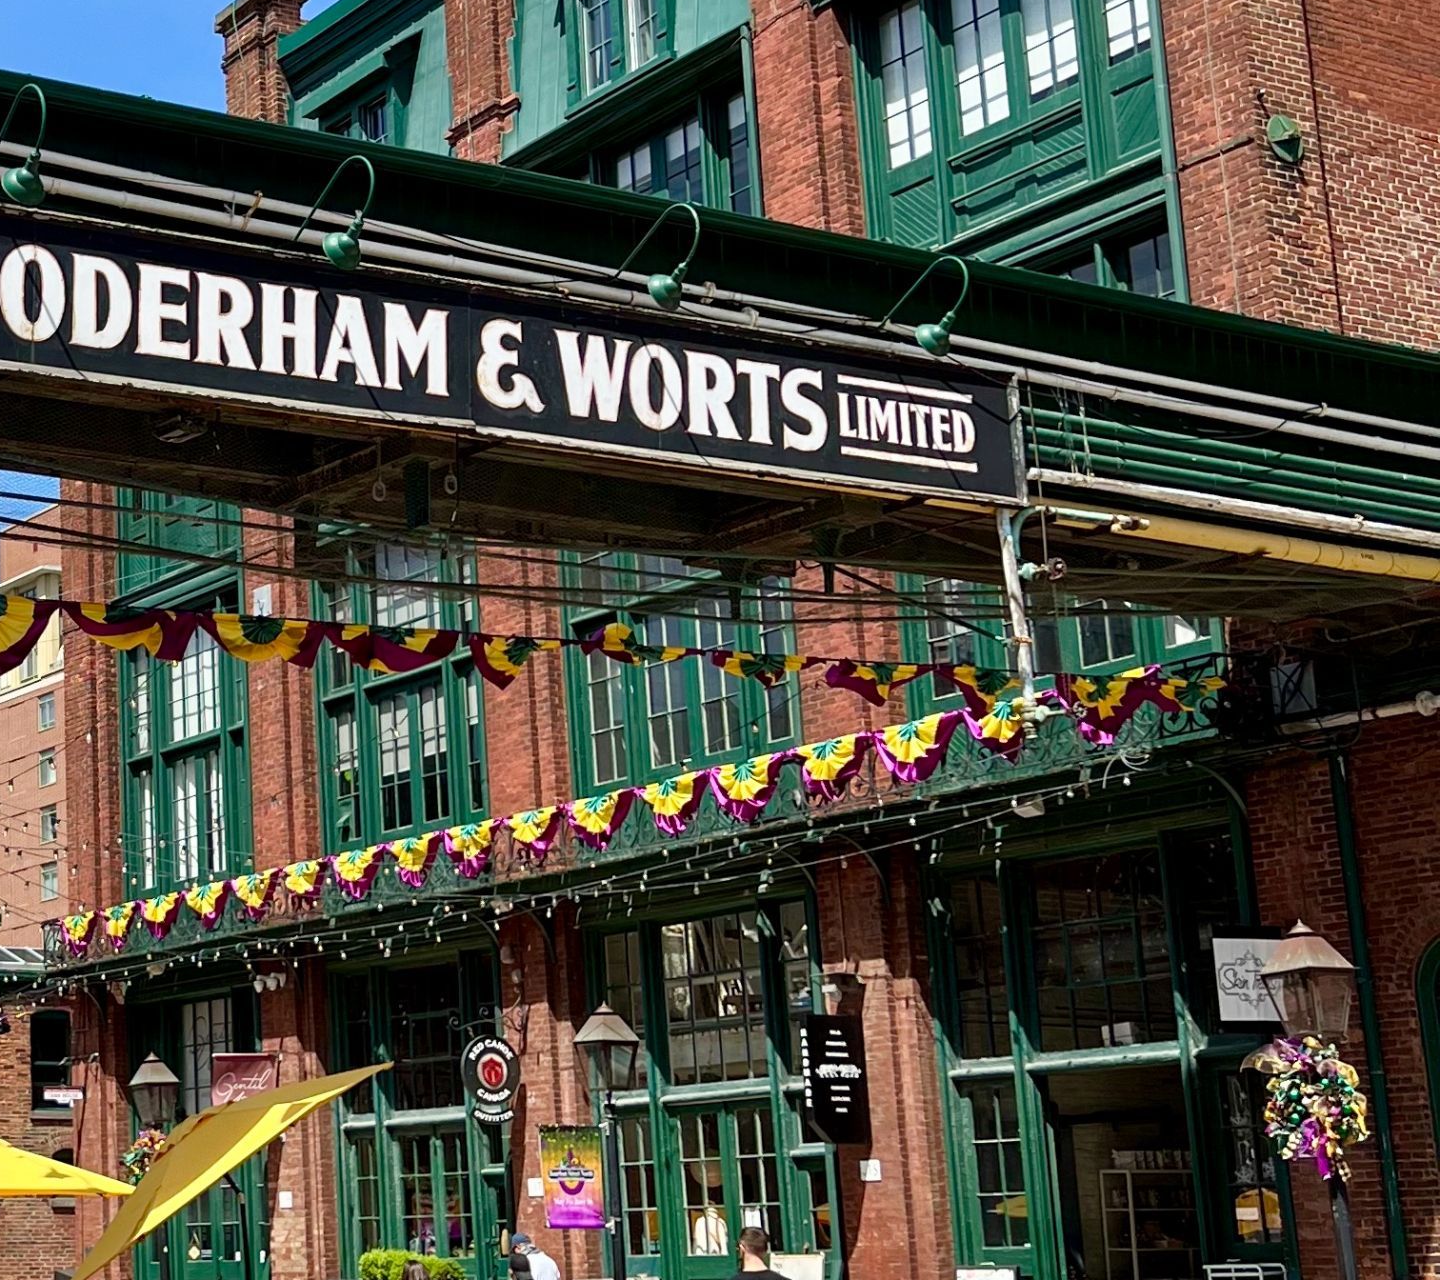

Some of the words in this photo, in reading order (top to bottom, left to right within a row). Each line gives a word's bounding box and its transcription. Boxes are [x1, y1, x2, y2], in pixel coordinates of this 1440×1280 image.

[475, 318, 546, 414] &
[553, 327, 830, 453] WORTS
[838, 392, 976, 454] LIMITED
[469, 1042, 485, 1061] RED
[485, 1039, 515, 1061] CANOE
[476, 1088, 512, 1102] CANADA
